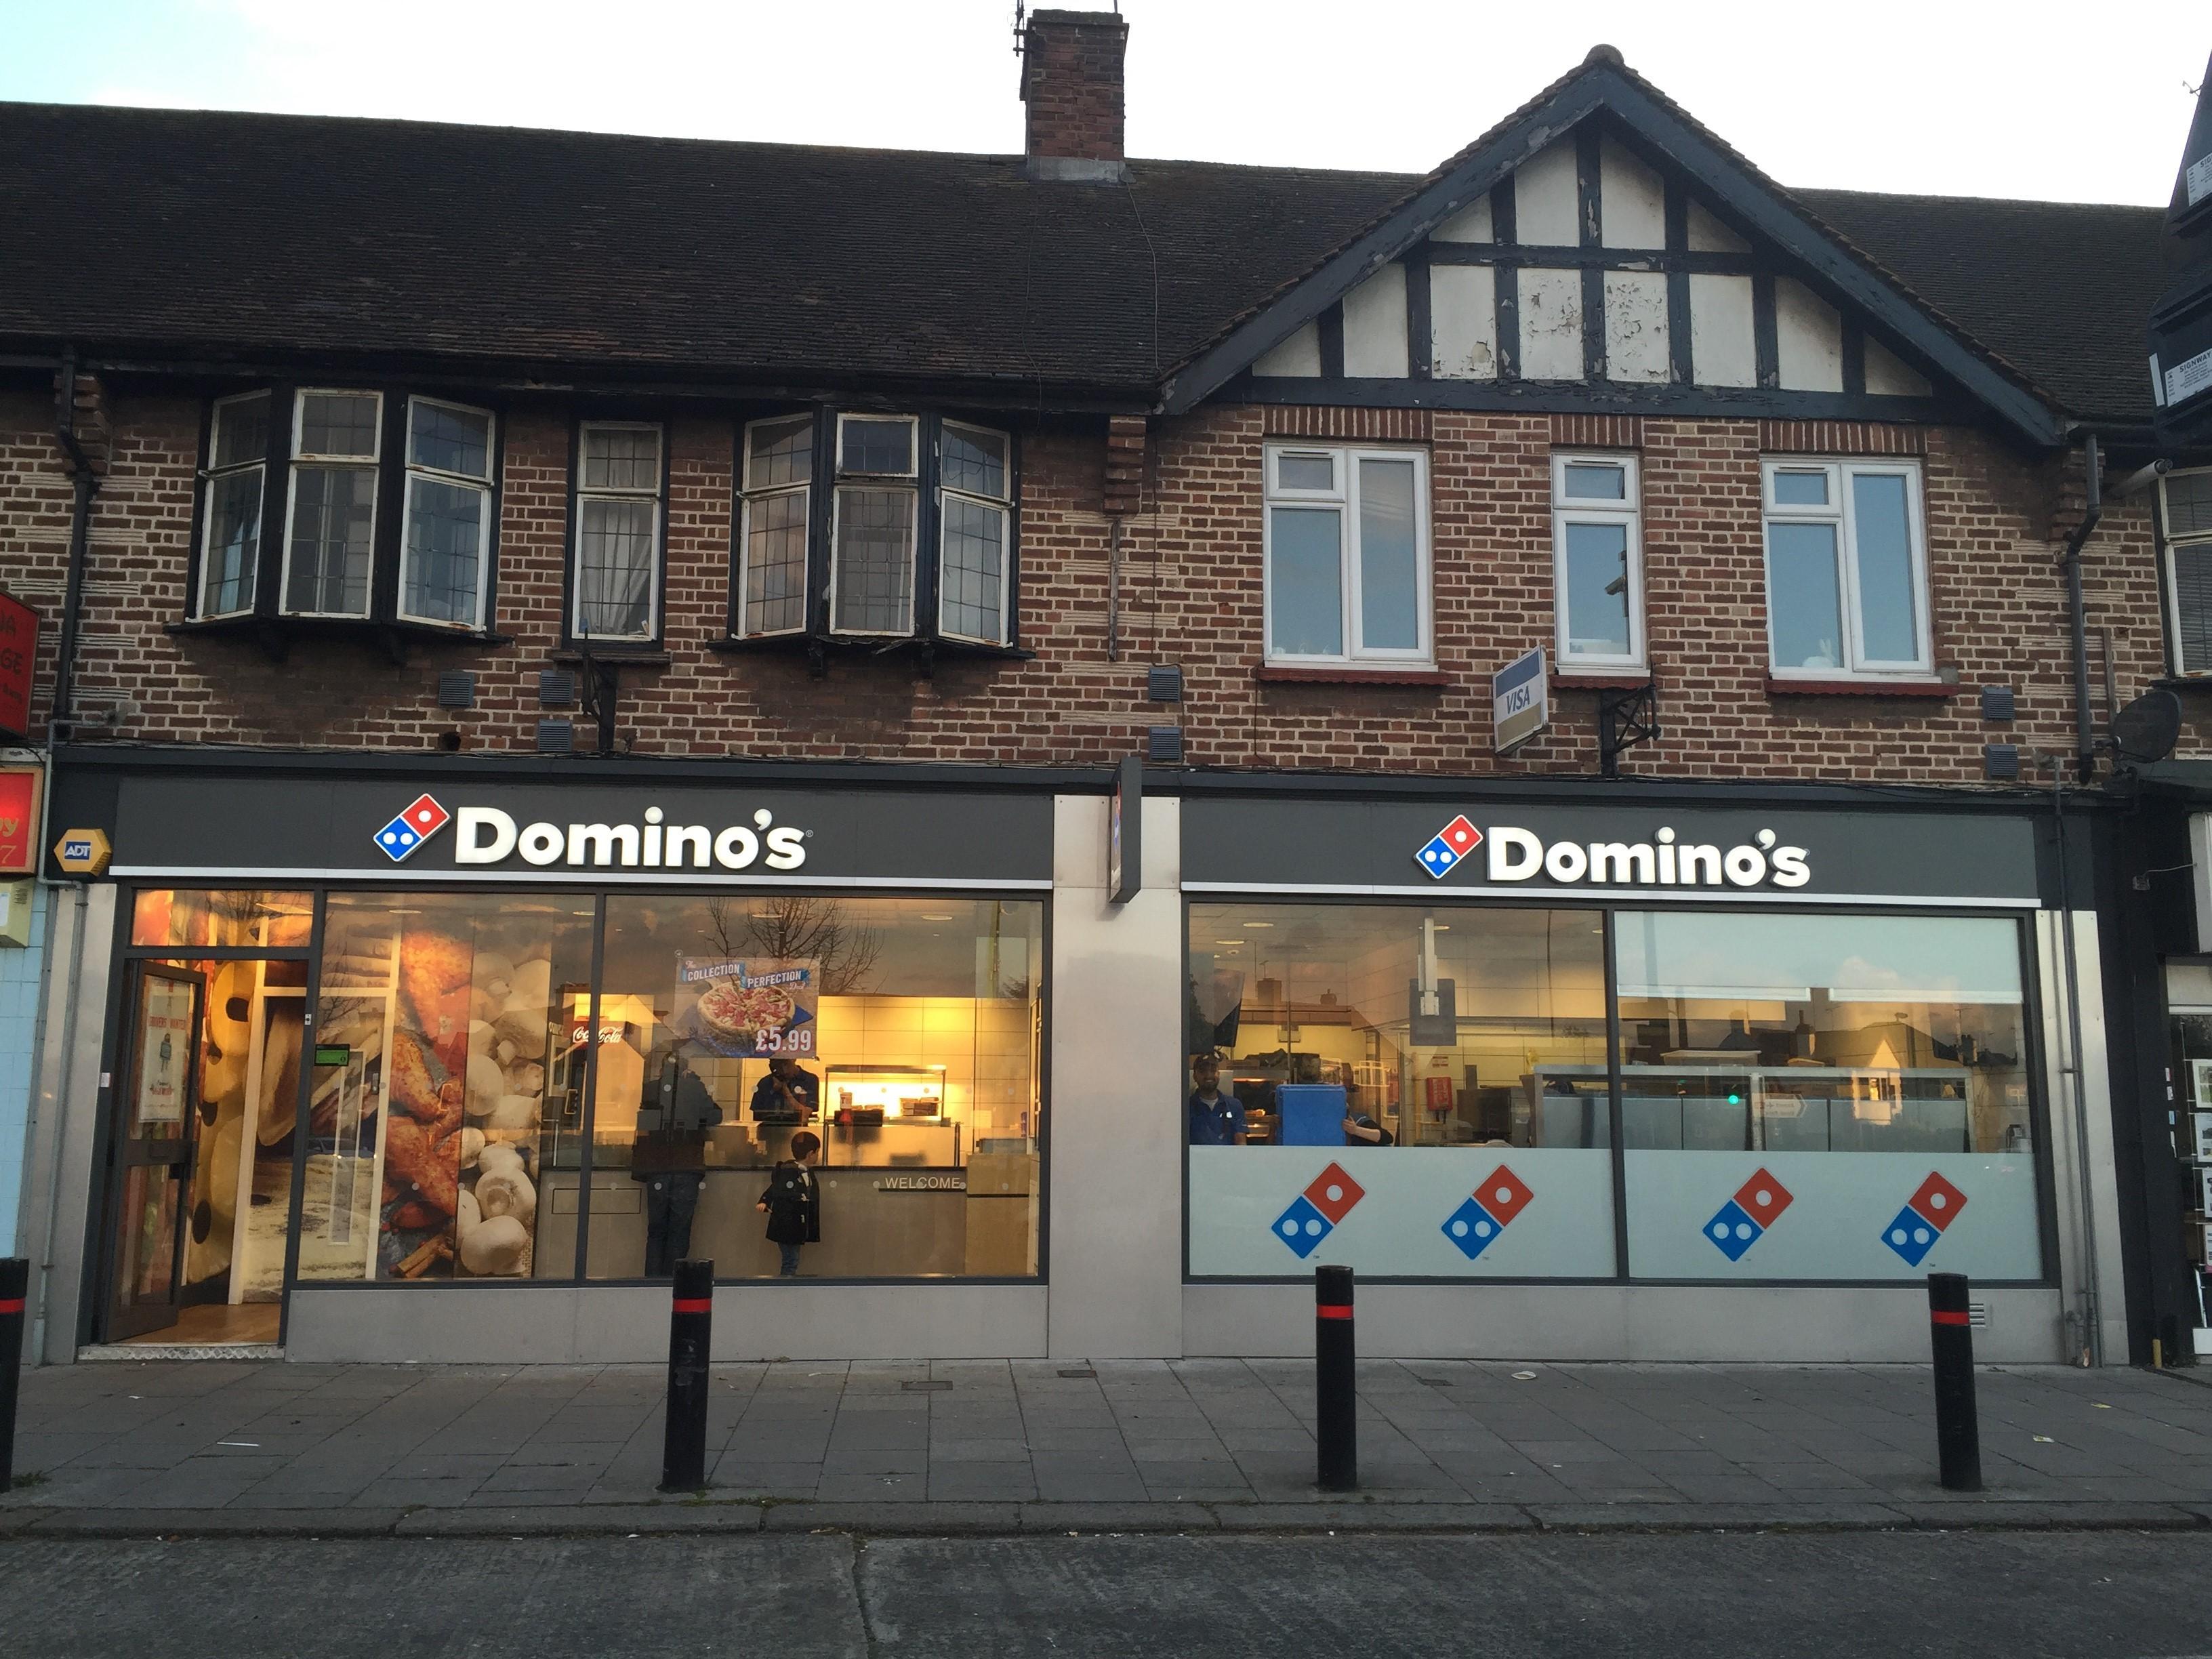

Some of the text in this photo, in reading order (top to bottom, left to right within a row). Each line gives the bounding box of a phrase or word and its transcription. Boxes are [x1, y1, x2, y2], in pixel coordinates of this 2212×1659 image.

[1507, 685, 1530, 714] VISA
[64, 845, 90, 857] ADT
[1487, 826, 1811, 887] Domino's
[688, 964, 740, 981] COLLECTION
[747, 970, 801, 988] PERFECTION
[756, 1025, 812, 1051] £5.99
[885, 1177, 960, 1189] WELCOME
